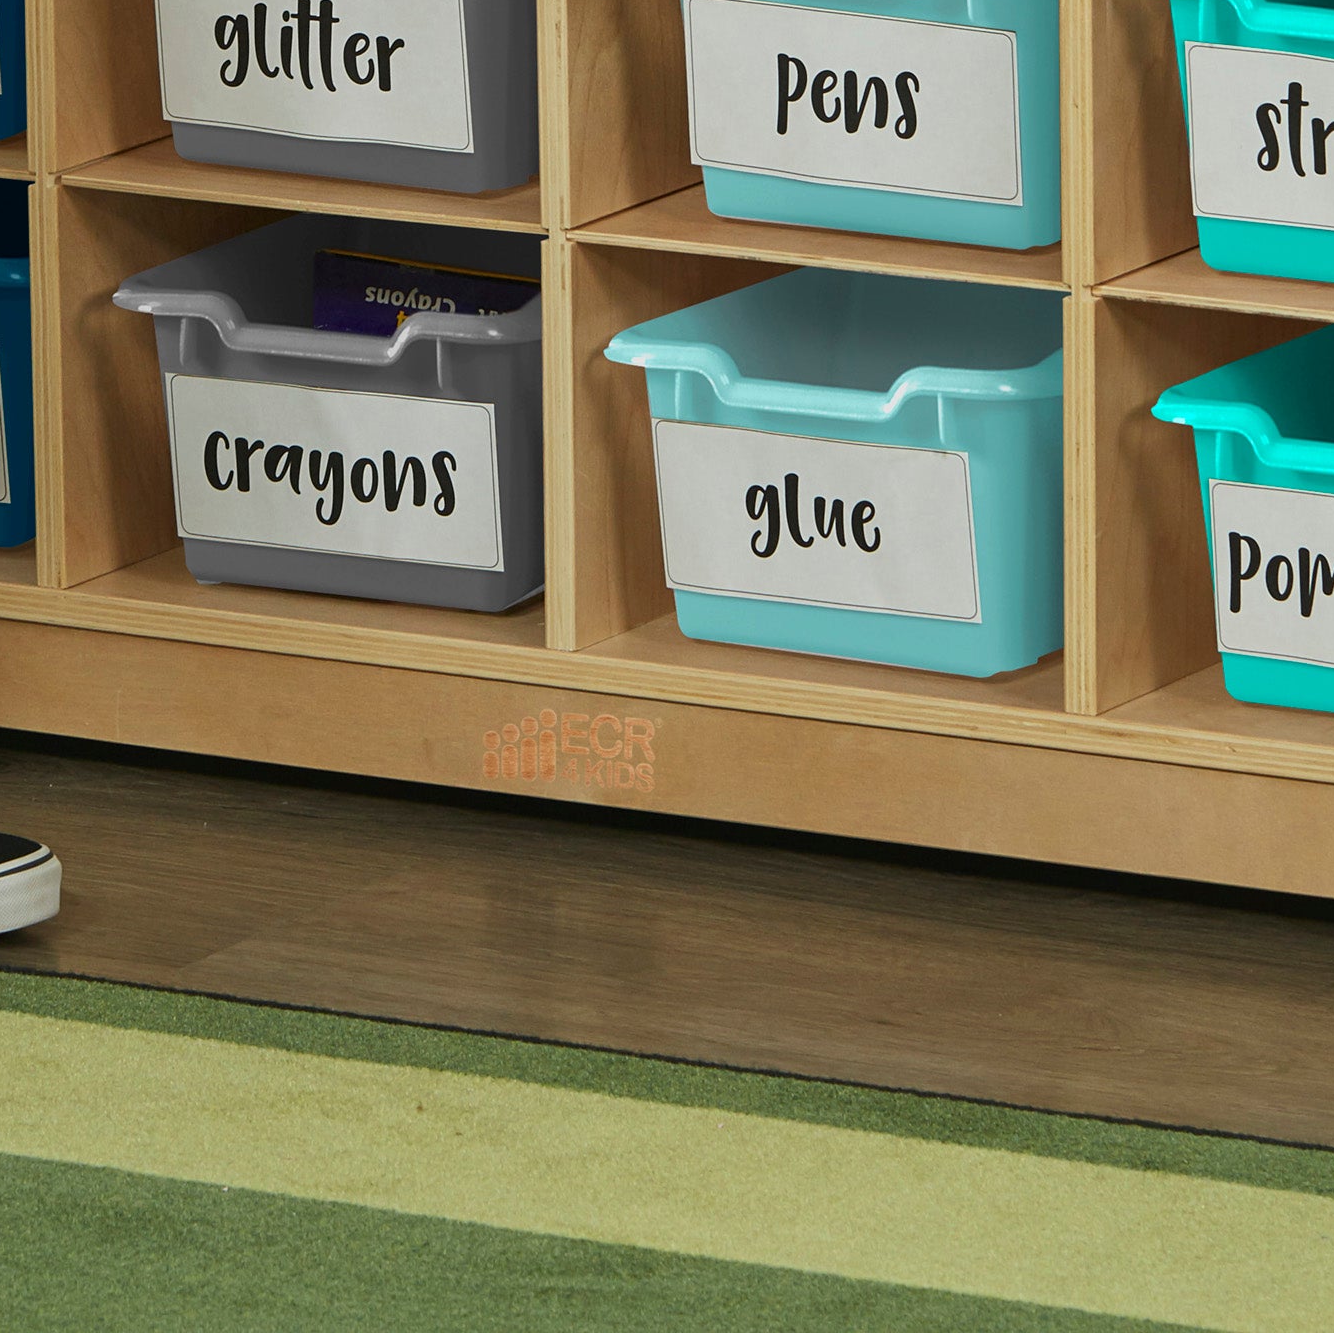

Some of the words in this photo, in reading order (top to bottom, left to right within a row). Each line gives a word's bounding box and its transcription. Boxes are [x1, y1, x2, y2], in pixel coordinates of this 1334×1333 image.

[776, 53, 920, 140] pens
[365, 285, 456, 315] Crayons
[204, 430, 457, 526] crayons
[745, 473, 881, 558] glue
[562, 757, 580, 785] 4
[585, 758, 656, 793] KIDS
